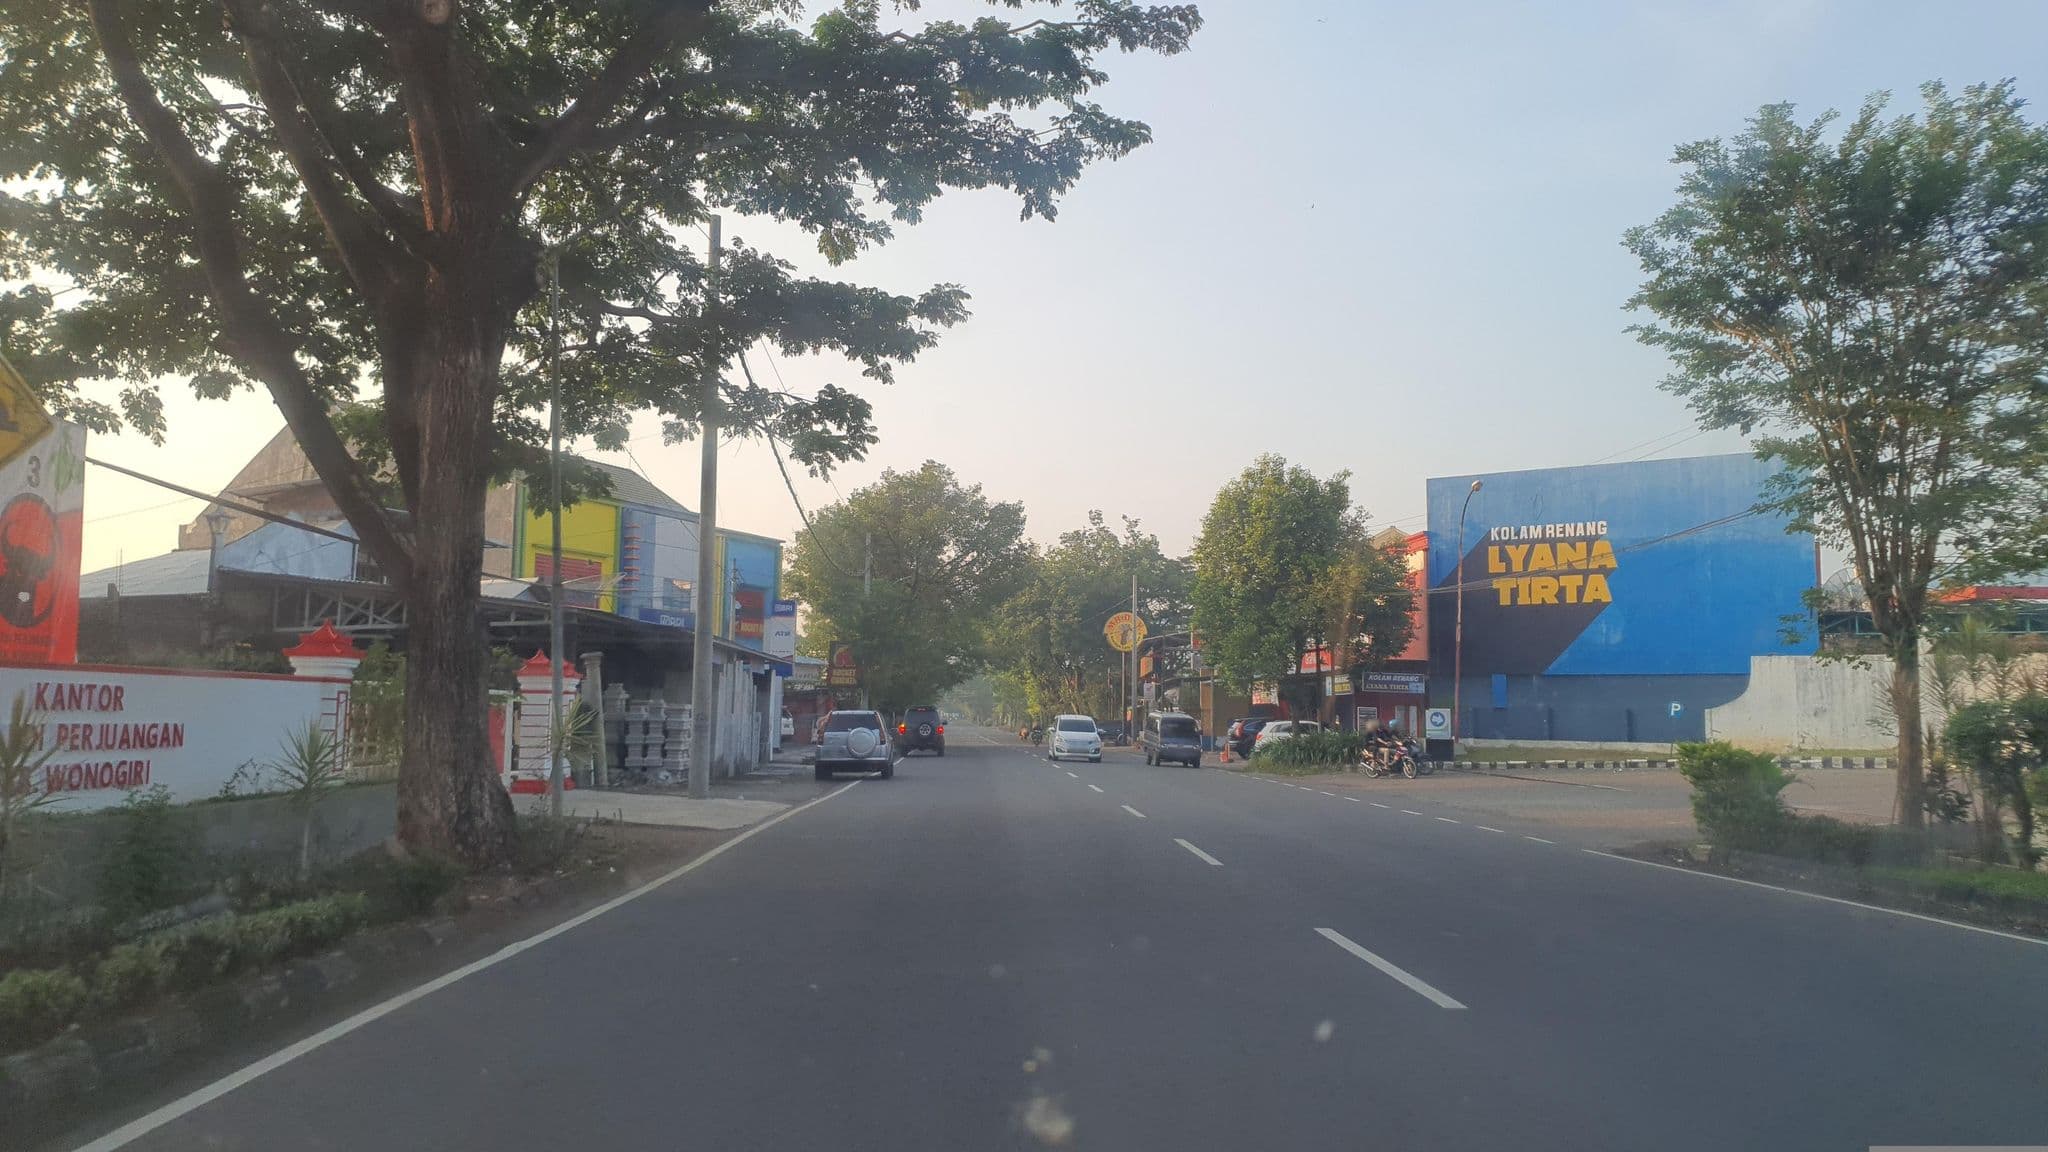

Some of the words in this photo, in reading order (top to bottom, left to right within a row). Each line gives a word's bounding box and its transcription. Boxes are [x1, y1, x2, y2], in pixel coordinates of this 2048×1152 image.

[27, 456, 41, 487] 3
[1490, 525, 1542, 541] KOLAM
[1545, 521, 1608, 538] RENANG
[1488, 540, 1618, 573] LYANA
[1492, 574, 1613, 606] TIRTA
[35, 682, 124, 711] KANTOR
[1671, 702, 1681, 716] P
[56, 723, 185, 750] PERJUANGAN
[46, 760, 150, 793] WONOGIRI
